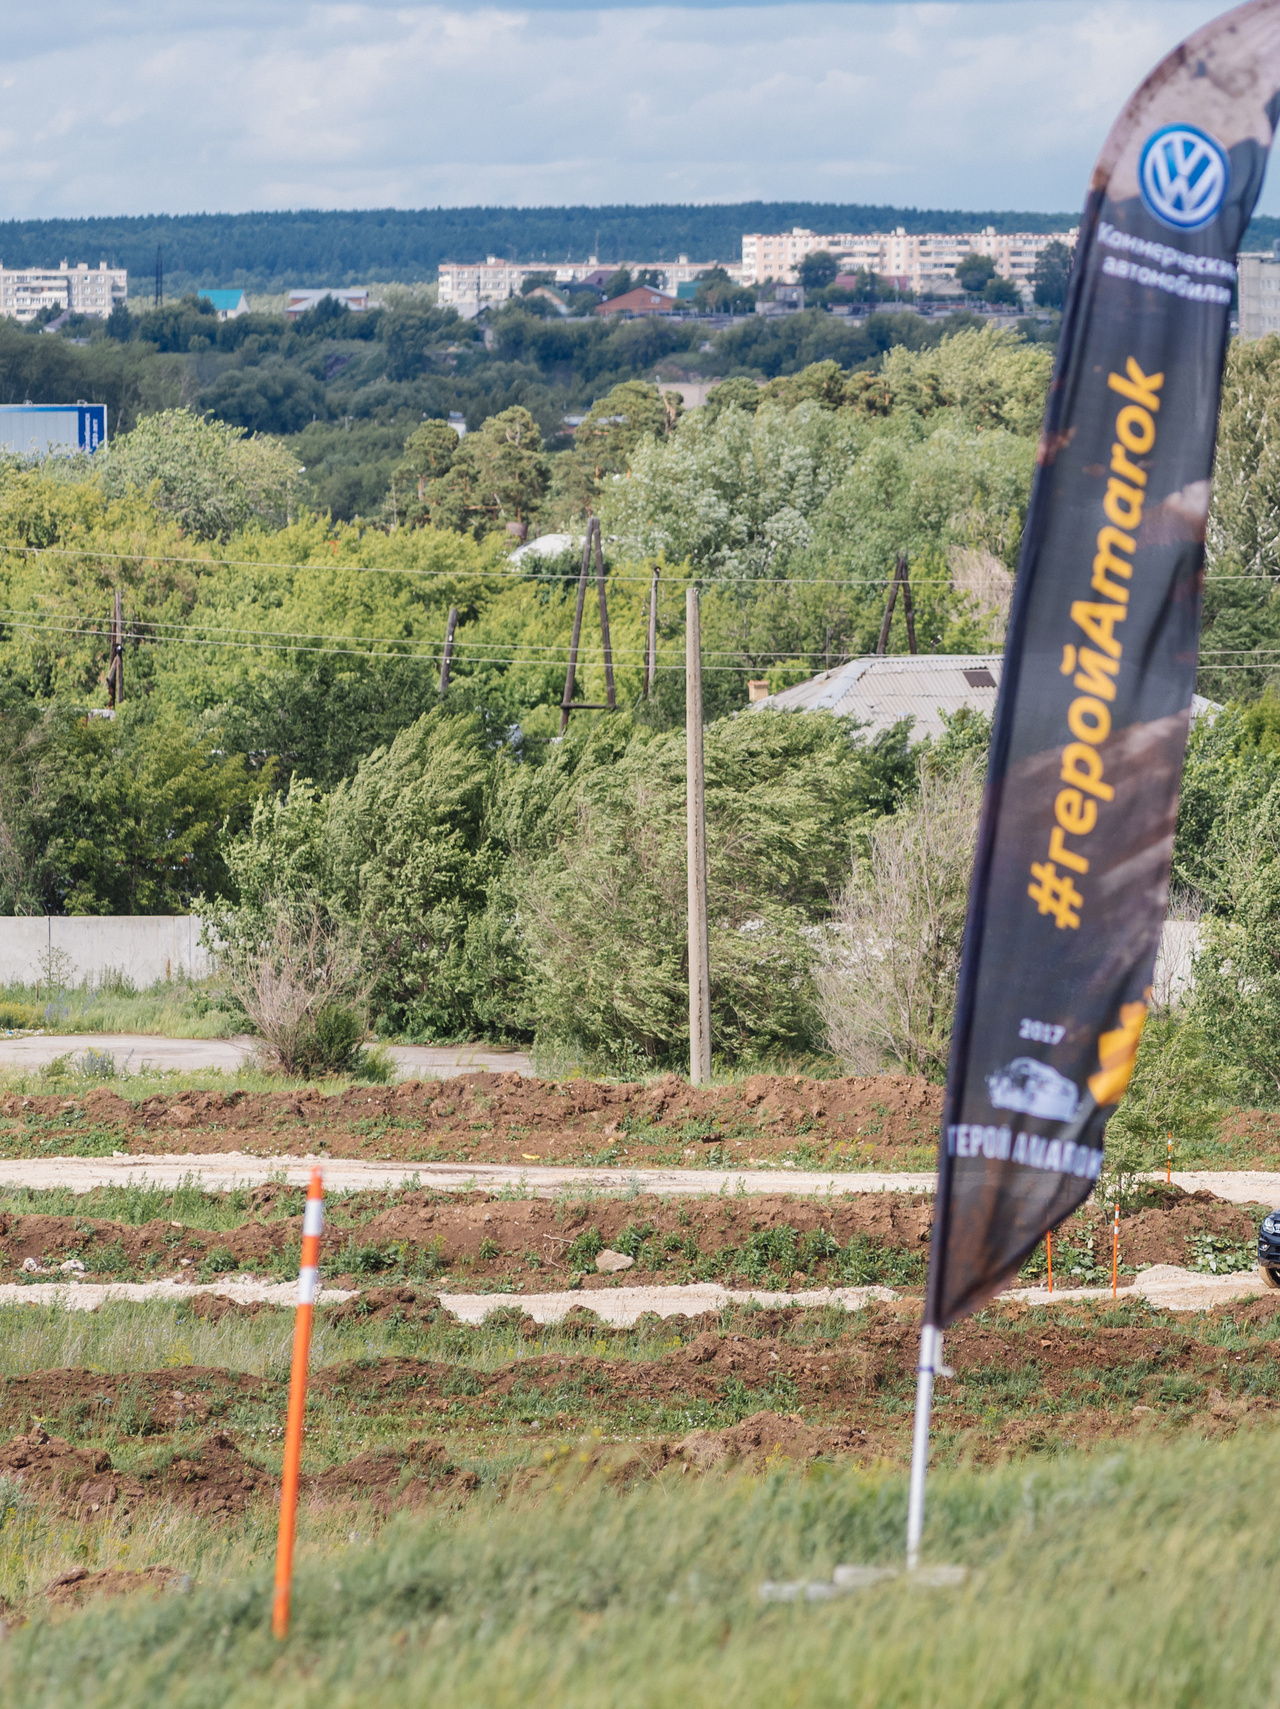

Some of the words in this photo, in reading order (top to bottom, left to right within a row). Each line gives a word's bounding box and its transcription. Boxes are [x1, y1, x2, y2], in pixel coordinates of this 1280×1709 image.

[1102, 255, 1231, 305] автомобили
[1027, 355, 1165, 930] #геройAmarok
[1018, 1017, 1066, 1046] 2017
